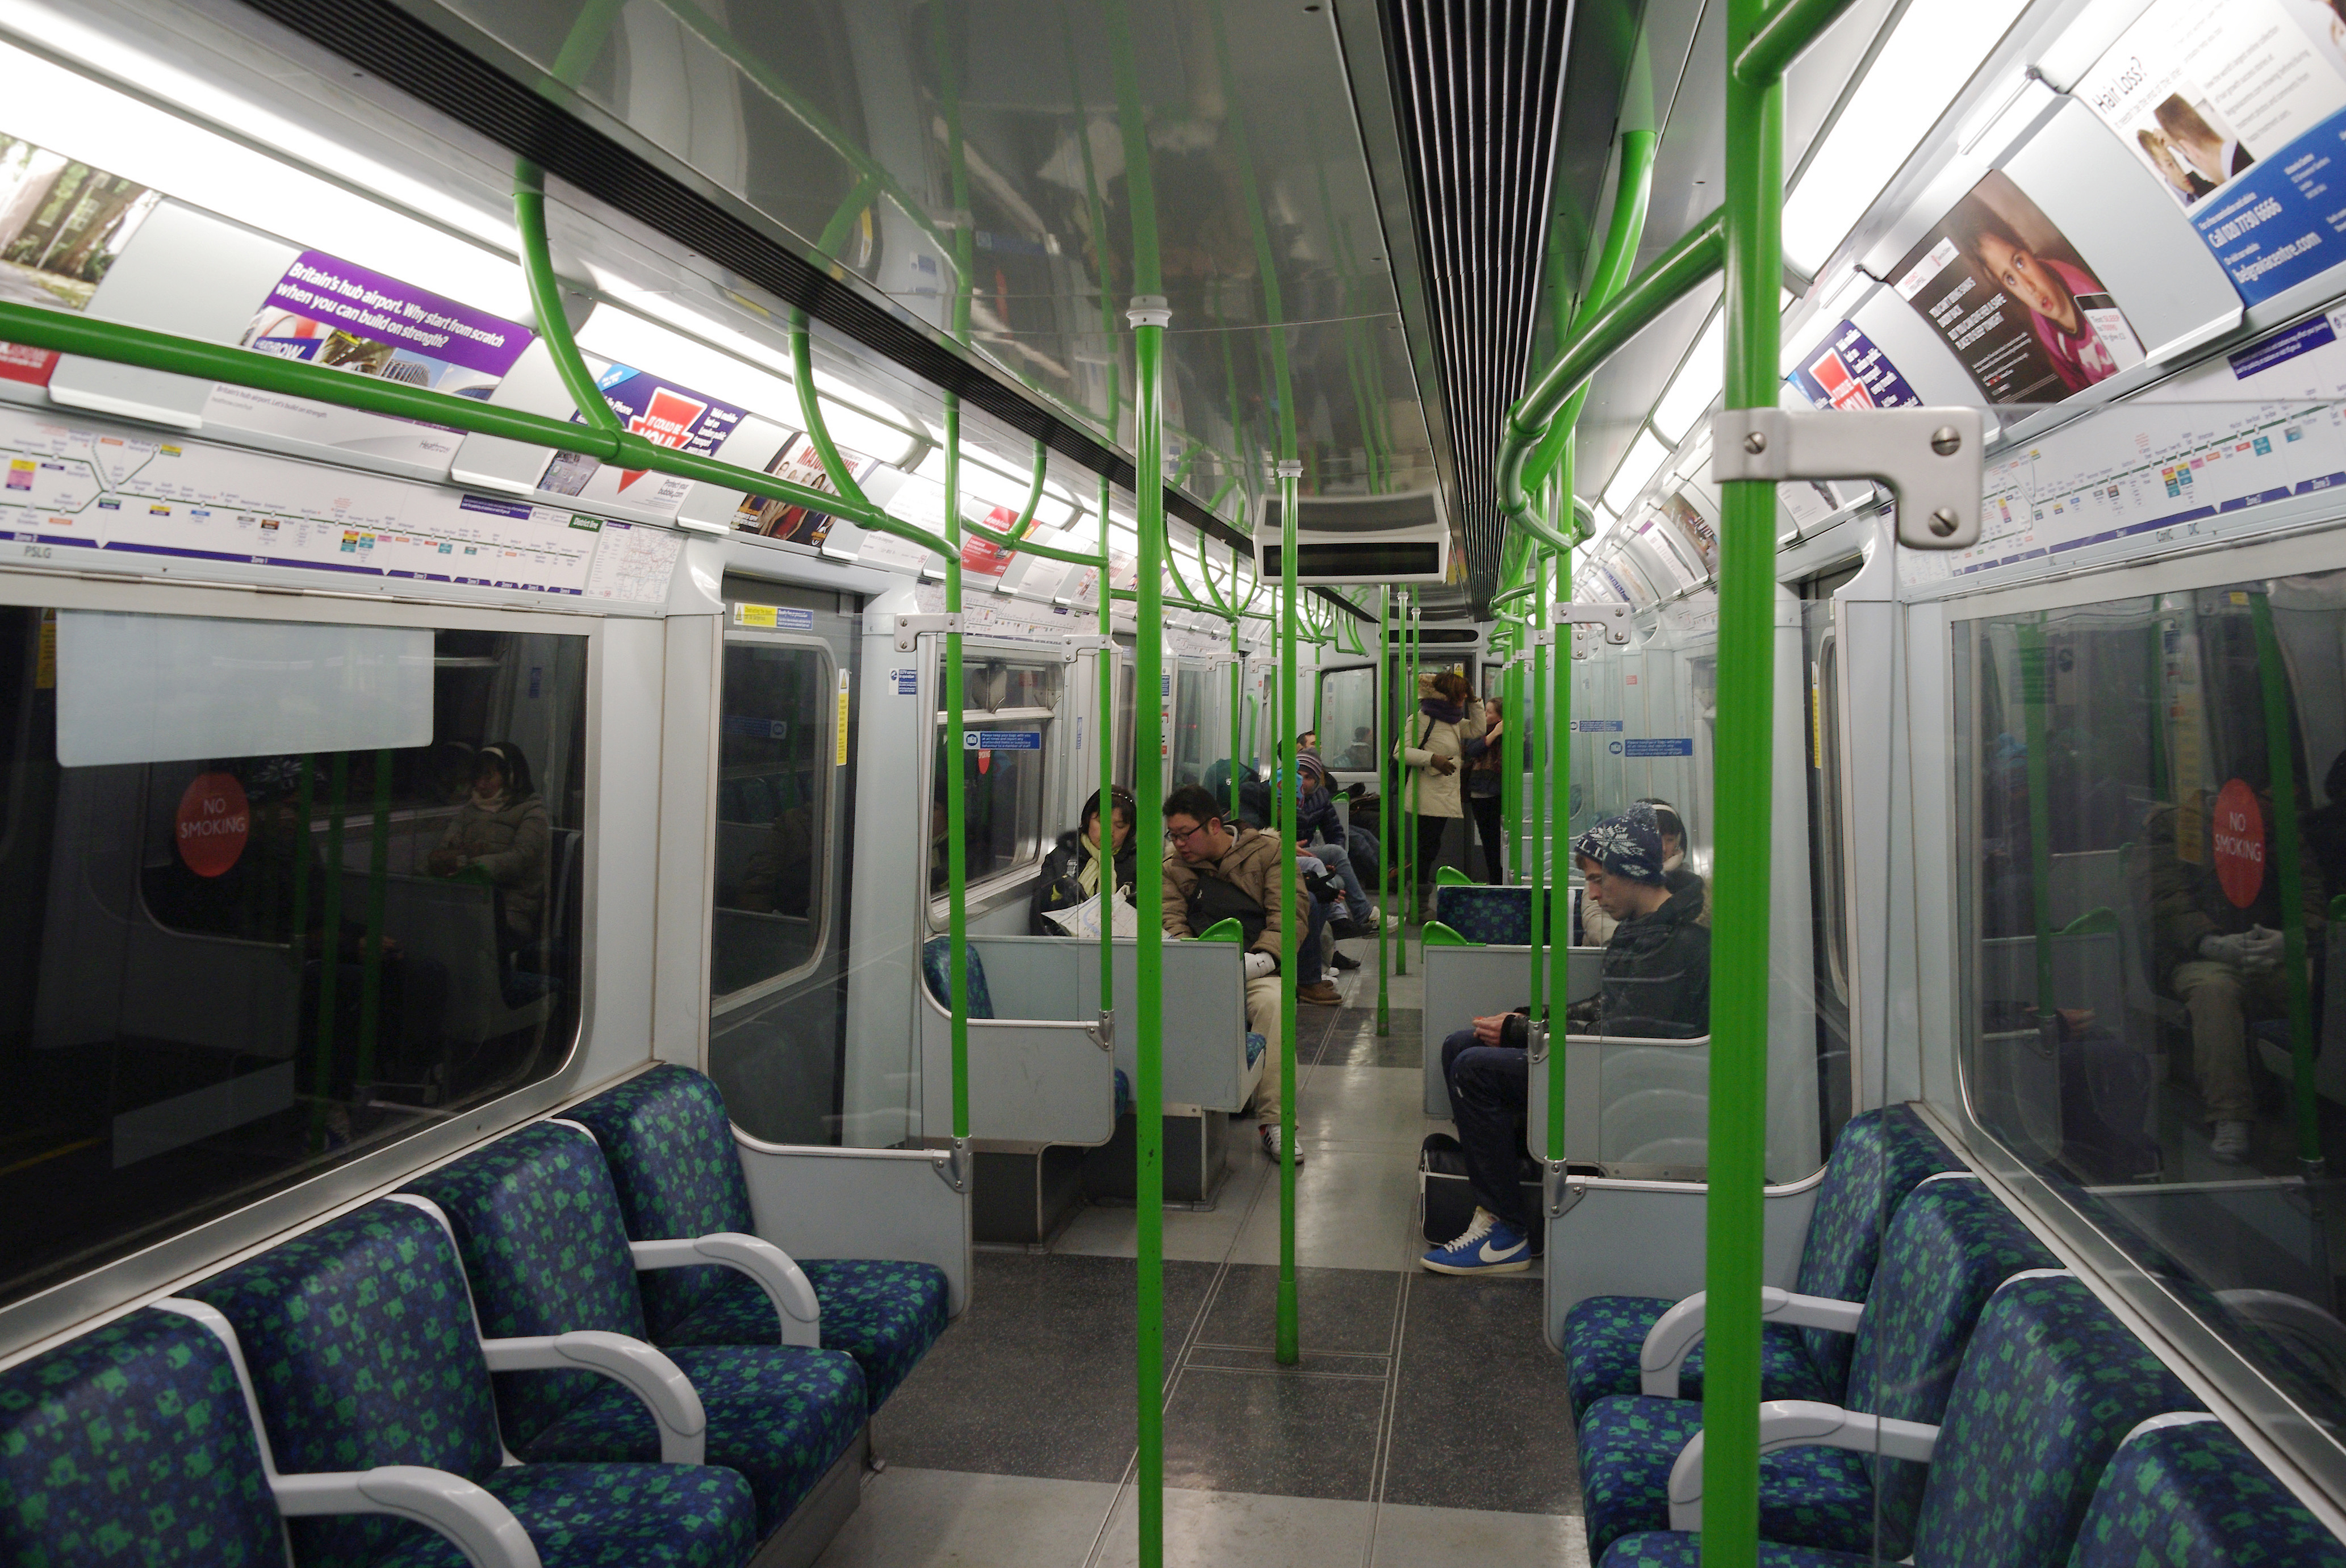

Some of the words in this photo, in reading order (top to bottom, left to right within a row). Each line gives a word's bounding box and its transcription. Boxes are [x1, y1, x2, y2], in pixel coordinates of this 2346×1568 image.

[2091, 78, 2122, 114] Hair
[2117, 57, 2147, 95] Loss?
[2208, 228, 2227, 248] Call
[2221, 221, 2240, 240] 020
[2234, 211, 2259, 232] 7730
[2253, 197, 2281, 221] 6666
[2232, 233, 2320, 282] belgraviacentre.com
[276, 283, 313, 303] when
[310, 295, 337, 312] you
[336, 304, 360, 320] can
[358, 310, 390, 329] build
[386, 321, 403, 334] on
[401, 326, 449, 347] strength?
[288, 262, 340, 290] Britain's
[337, 279, 363, 299] hub
[361, 290, 402, 313] airport.
[403, 303, 428, 323] Why
[424, 313, 451, 329] start
[448, 319, 473, 336] from
[470, 329, 504, 347] scratch
[613, 400, 633, 415] Phone
[646, 416, 654, 426] IT
[653, 417, 673, 432] COULD
[672, 423, 683, 434] BE
[573, 517, 588, 527] District
[588, 520, 599, 529] line
[203, 798, 226, 814] NO
[180, 817, 246, 838] SMOKING
[2228, 811, 2246, 830] NO
[2215, 836, 2261, 862] SMOKING
